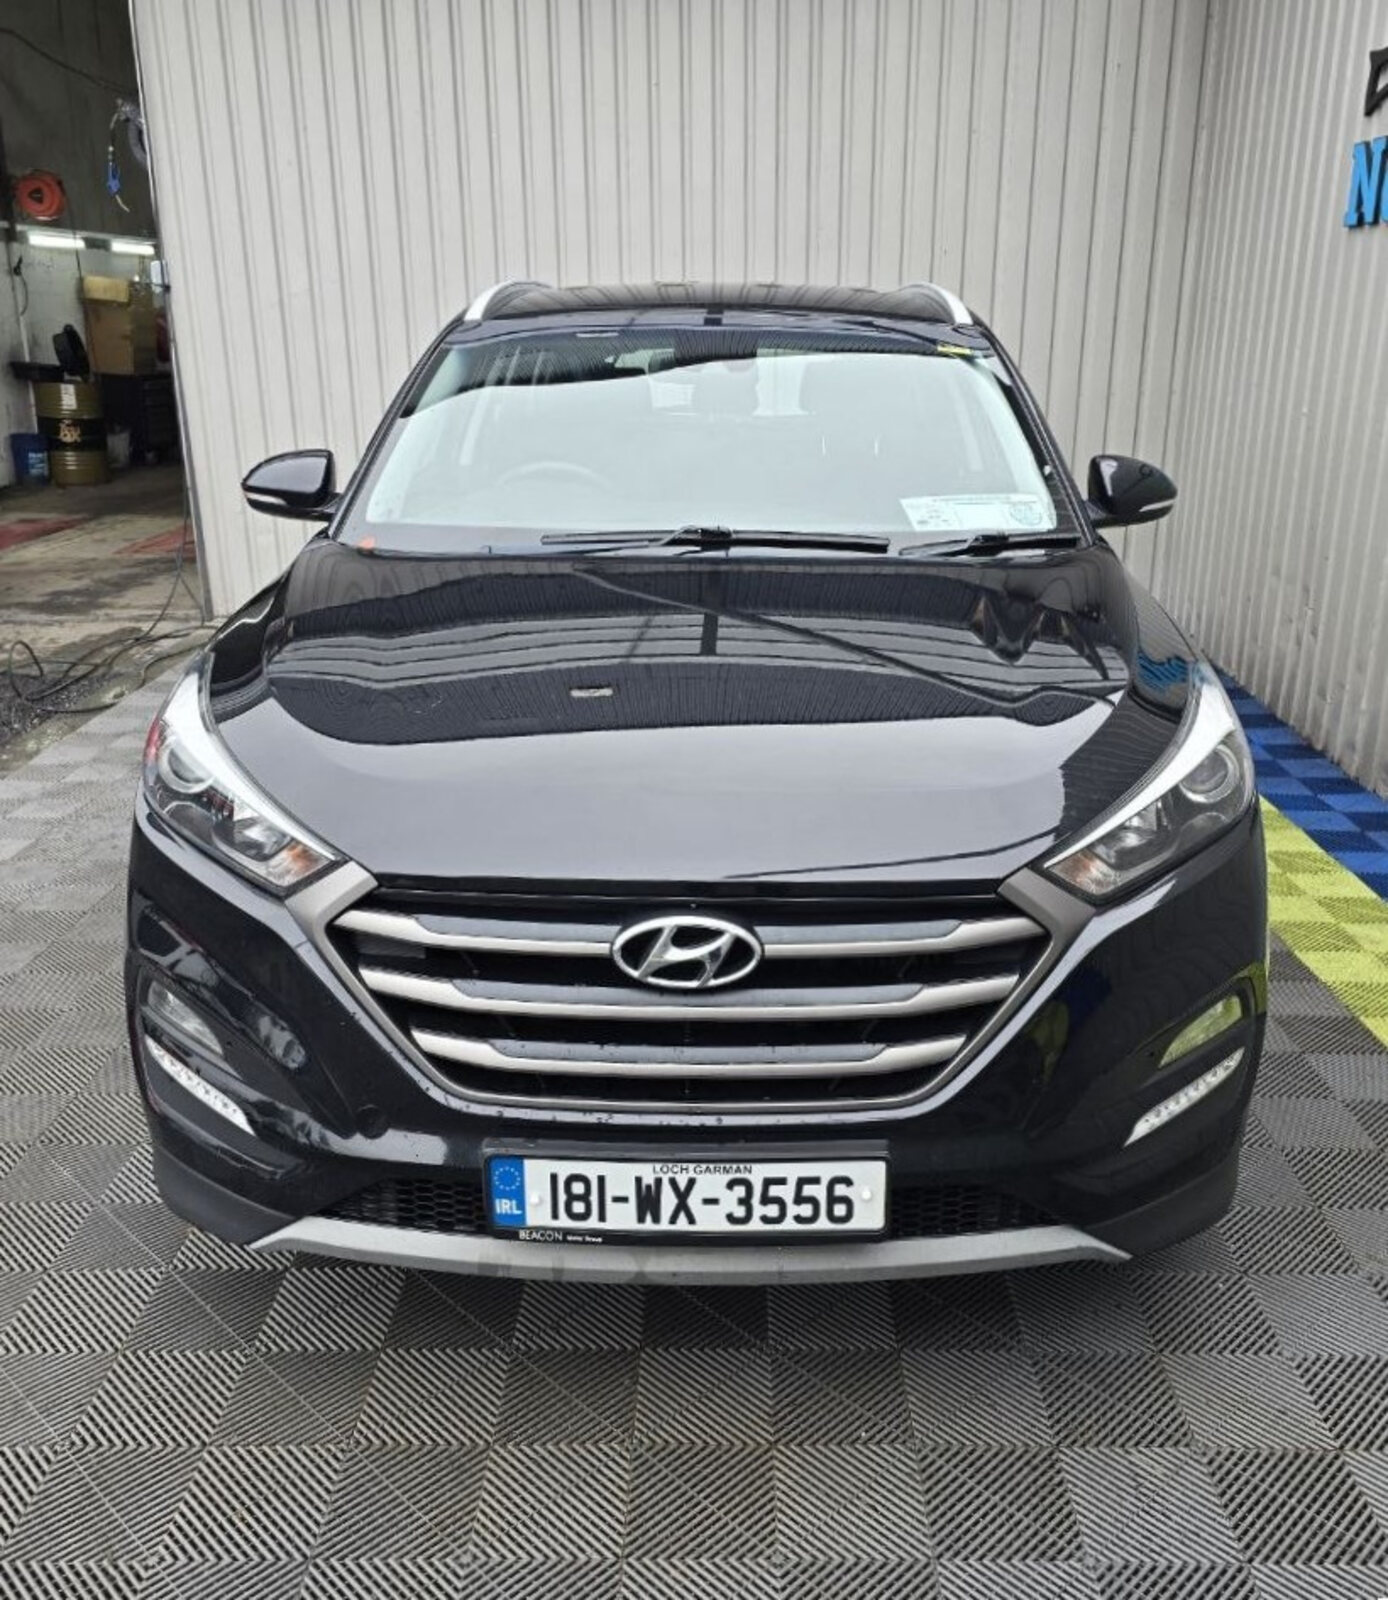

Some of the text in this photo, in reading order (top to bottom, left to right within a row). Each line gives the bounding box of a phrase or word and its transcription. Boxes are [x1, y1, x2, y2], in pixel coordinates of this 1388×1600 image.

[1344, 137, 1388, 227] N
[653, 1164, 753, 1176] LOCH GARMAN
[550, 1172, 854, 1225] 181-WX-3556
[495, 1199, 522, 1214] IRL
[519, 1229, 563, 1241] BEACON
